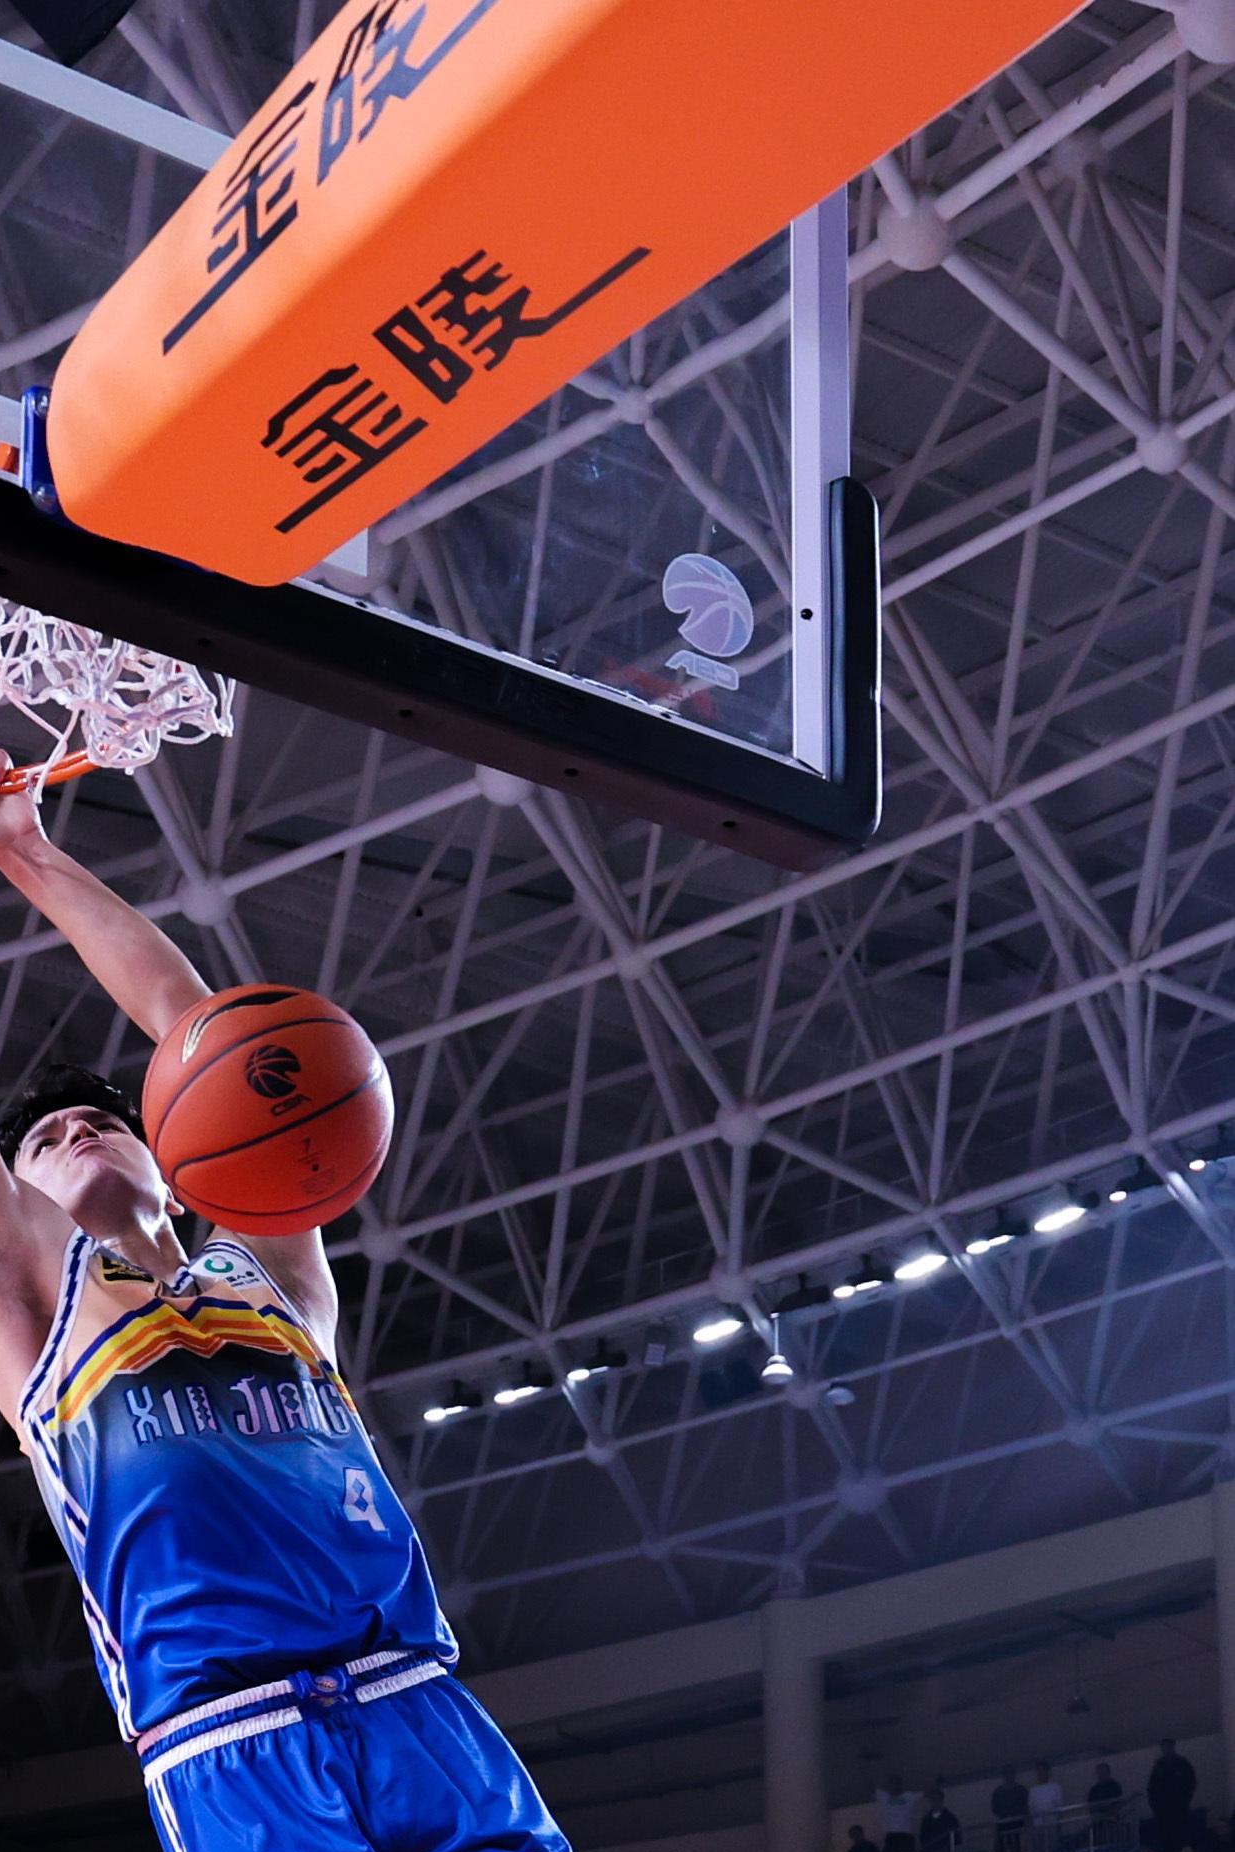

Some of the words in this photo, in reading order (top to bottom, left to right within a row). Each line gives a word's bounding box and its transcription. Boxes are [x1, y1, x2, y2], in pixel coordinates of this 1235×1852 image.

[162, 0, 500, 357] 金陵
[260, 247, 653, 535] 金陵
[125, 1384, 218, 1444] XIN
[229, 1375, 350, 1438] JIANG
[343, 1467, 390, 1534] 4
